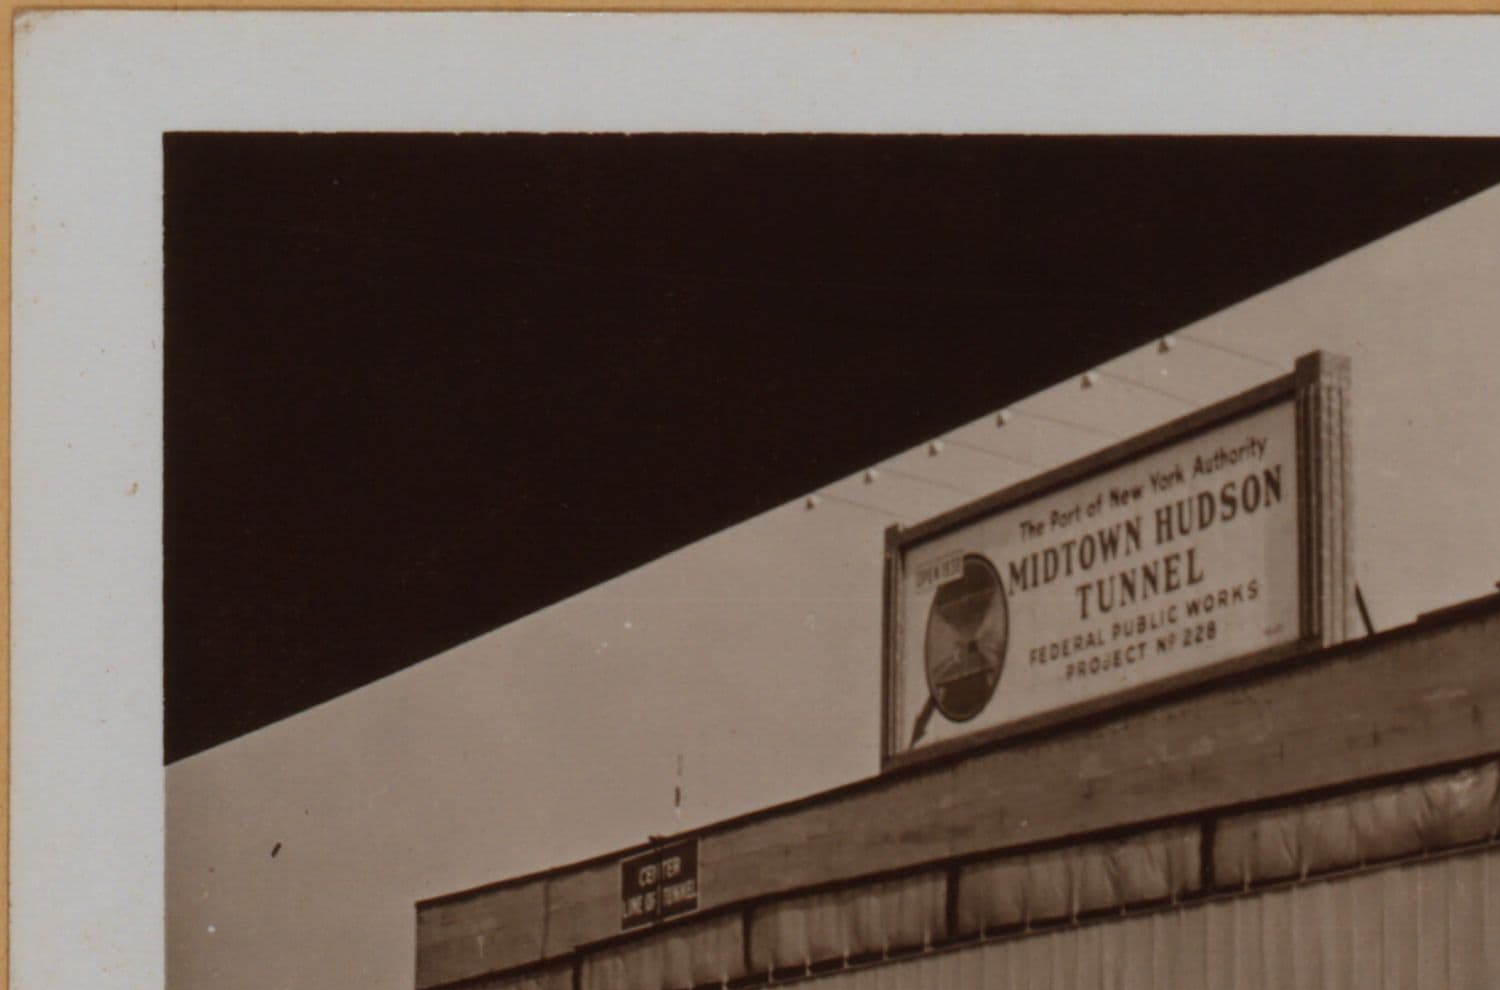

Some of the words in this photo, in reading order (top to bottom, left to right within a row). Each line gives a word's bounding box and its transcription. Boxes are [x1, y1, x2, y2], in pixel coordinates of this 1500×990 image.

[1007, 514, 1143, 598] MIDTOWN
[1153, 462, 1284, 546] HUDSON
[1019, 519, 1045, 539] The
[1049, 503, 1081, 532] Port
[1086, 492, 1104, 518] of
[1109, 484, 1143, 508] New
[1149, 463, 1184, 494] York
[1193, 436, 1267, 479] Authority
[1028, 627, 1106, 669] FEDERAL
[1111, 603, 1178, 642] PUBLIC
[1185, 577, 1260, 618] WORKS
[1074, 546, 1205, 621] TUNNEL
[1065, 641, 1148, 681] PROJECT
[1182, 618, 1217, 649] 228
